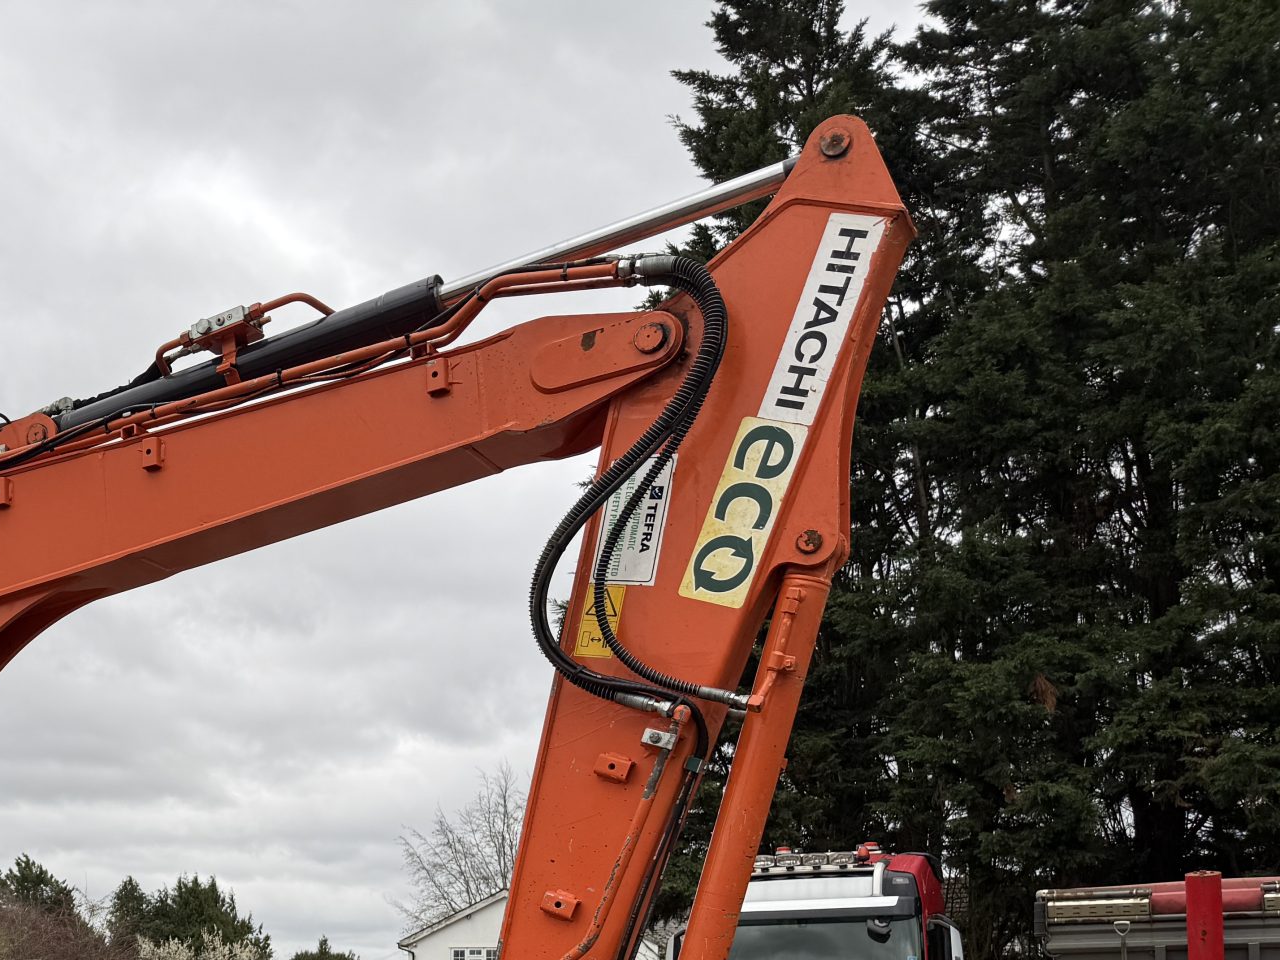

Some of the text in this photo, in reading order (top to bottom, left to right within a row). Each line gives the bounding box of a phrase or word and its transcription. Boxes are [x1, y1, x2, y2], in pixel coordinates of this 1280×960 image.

[774, 227, 869, 412] HITACHI
[627, 511, 642, 551] AUTOMATIC
[639, 502, 659, 554] TEFRA
[610, 554, 622, 577] FITTED
